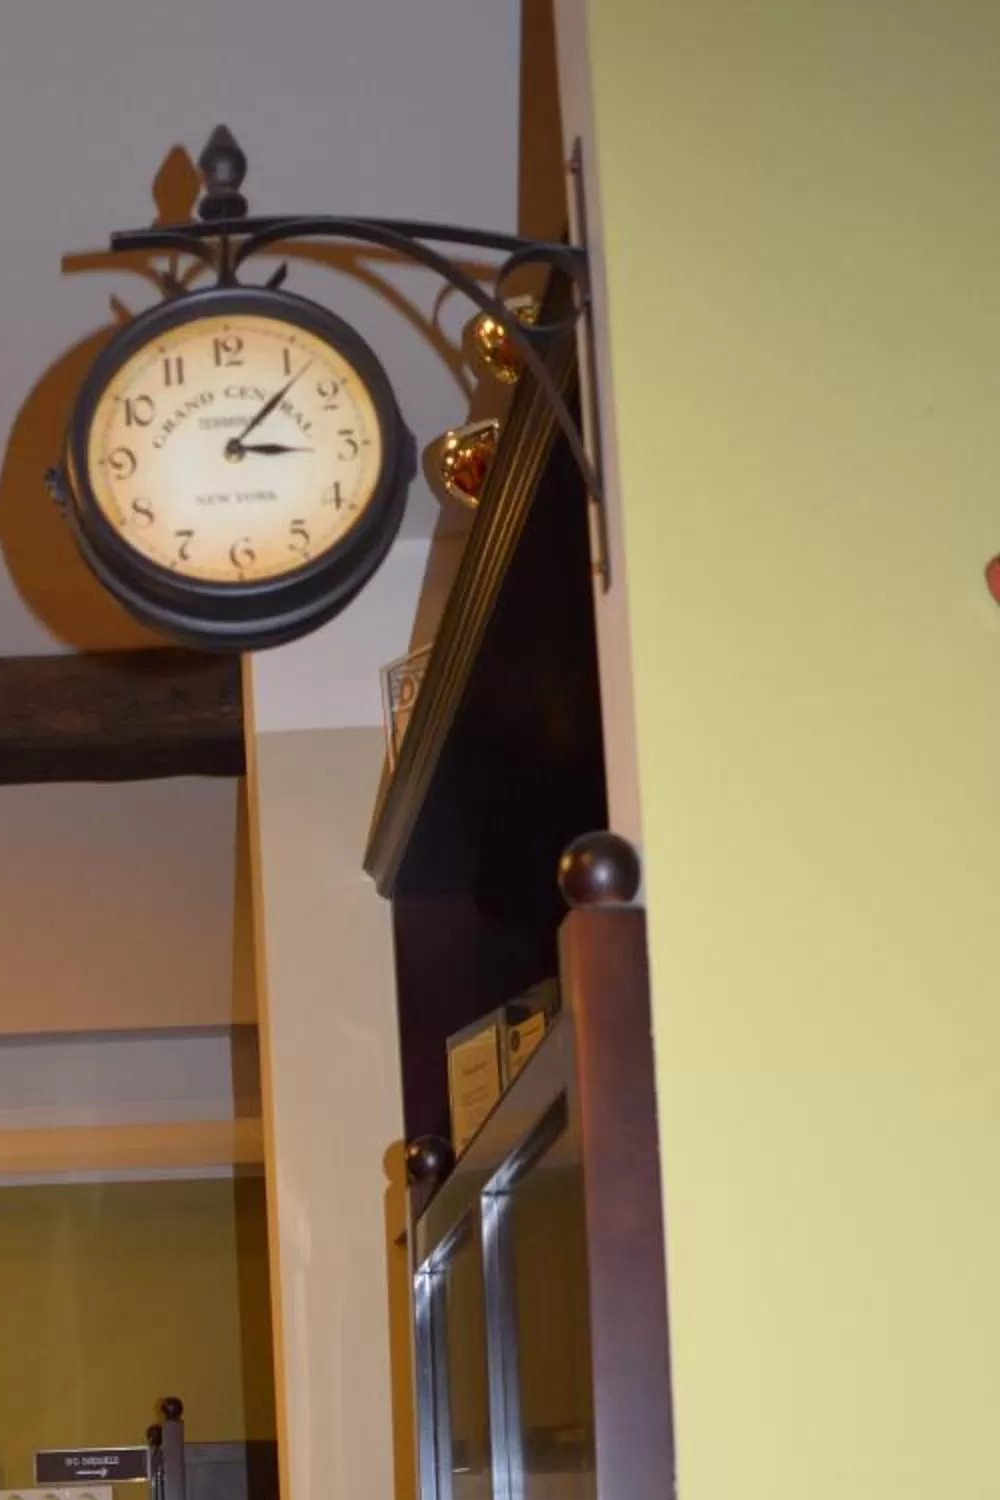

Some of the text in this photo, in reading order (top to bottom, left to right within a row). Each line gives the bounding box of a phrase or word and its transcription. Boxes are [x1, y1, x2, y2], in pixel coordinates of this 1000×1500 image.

[213, 335, 245, 368] 12
[282, 347, 291, 377] 1
[163, 355, 185, 388] 11
[122, 393, 156, 429] 10
[315, 379, 340, 413] 2
[151, 384, 314, 449] GRAND CENRAL
[336, 427, 360, 462] 3
[108, 446, 138, 481] 9
[130, 495, 157, 528] 8
[195, 489, 278, 505] NEW YORK
[320, 480, 345, 512] 4
[173, 528, 197, 562] 7
[288, 518, 311, 553] 5
[228, 536, 257, 569] 6
